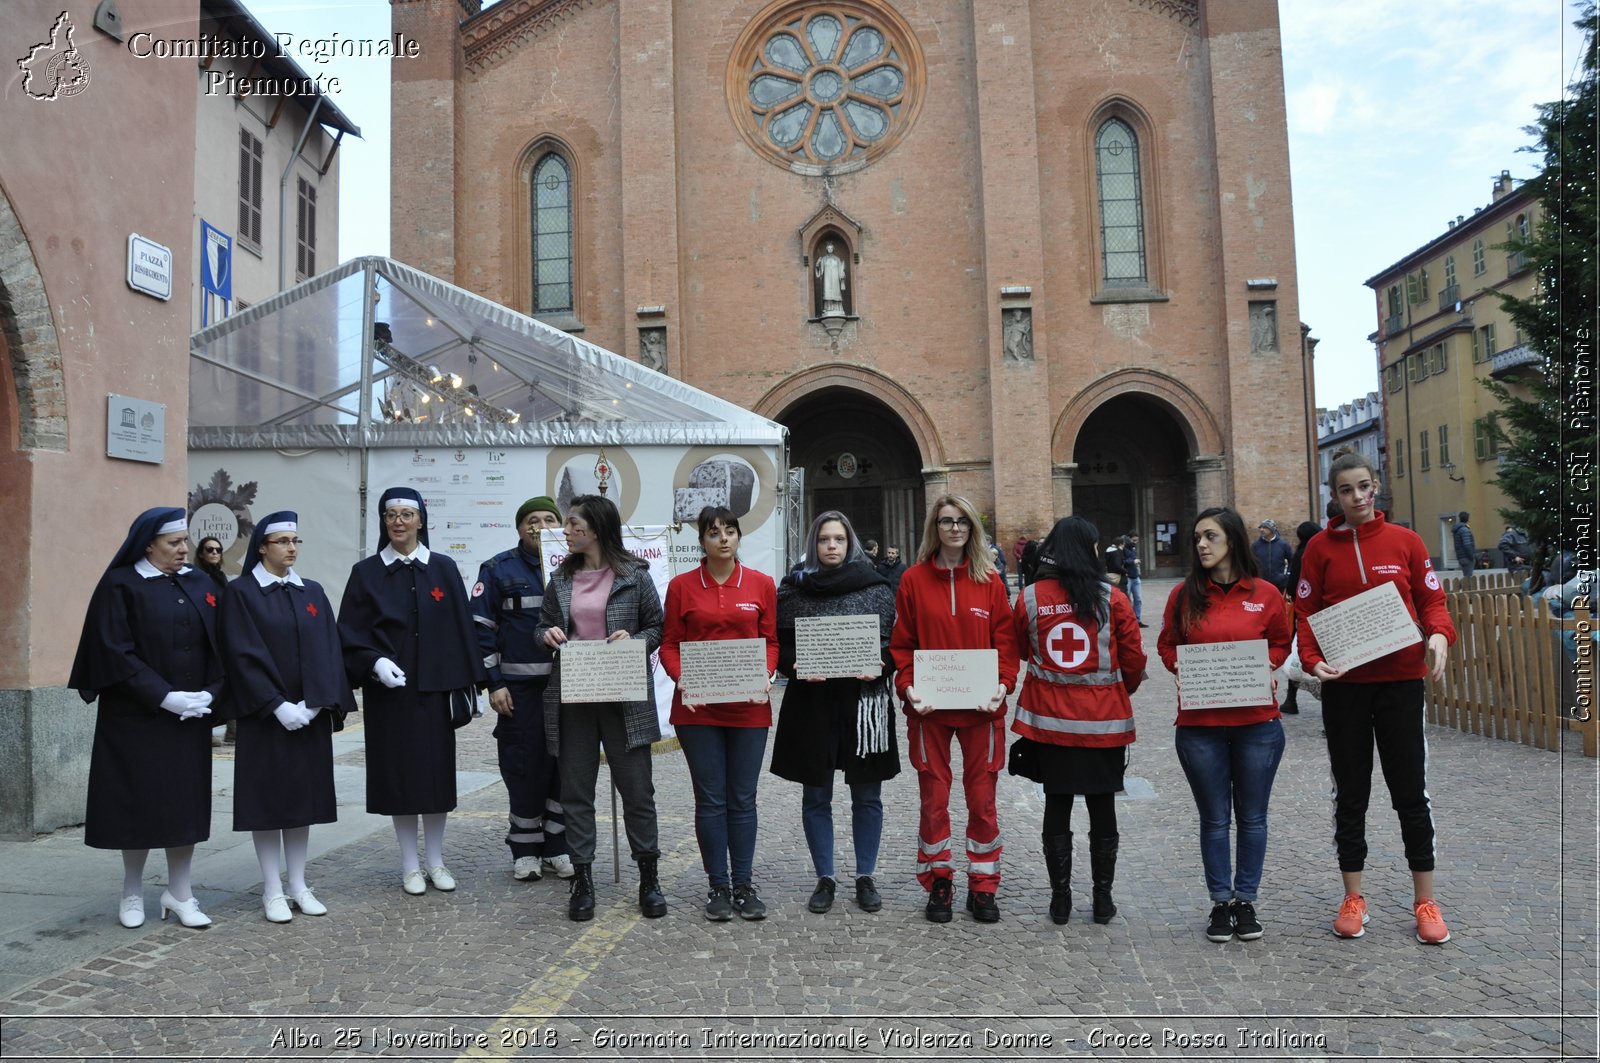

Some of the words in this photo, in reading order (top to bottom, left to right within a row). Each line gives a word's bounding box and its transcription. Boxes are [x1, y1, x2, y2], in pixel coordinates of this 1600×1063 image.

[140, 251, 163, 268] PIAZZA
[134, 264, 168, 284] RISORGIMENTO
[210, 513, 222, 522] Tra
[200, 519, 232, 531] Terra
[1038, 605, 1054, 615] CROCE
[1056, 604, 1072, 613] ROSSA
